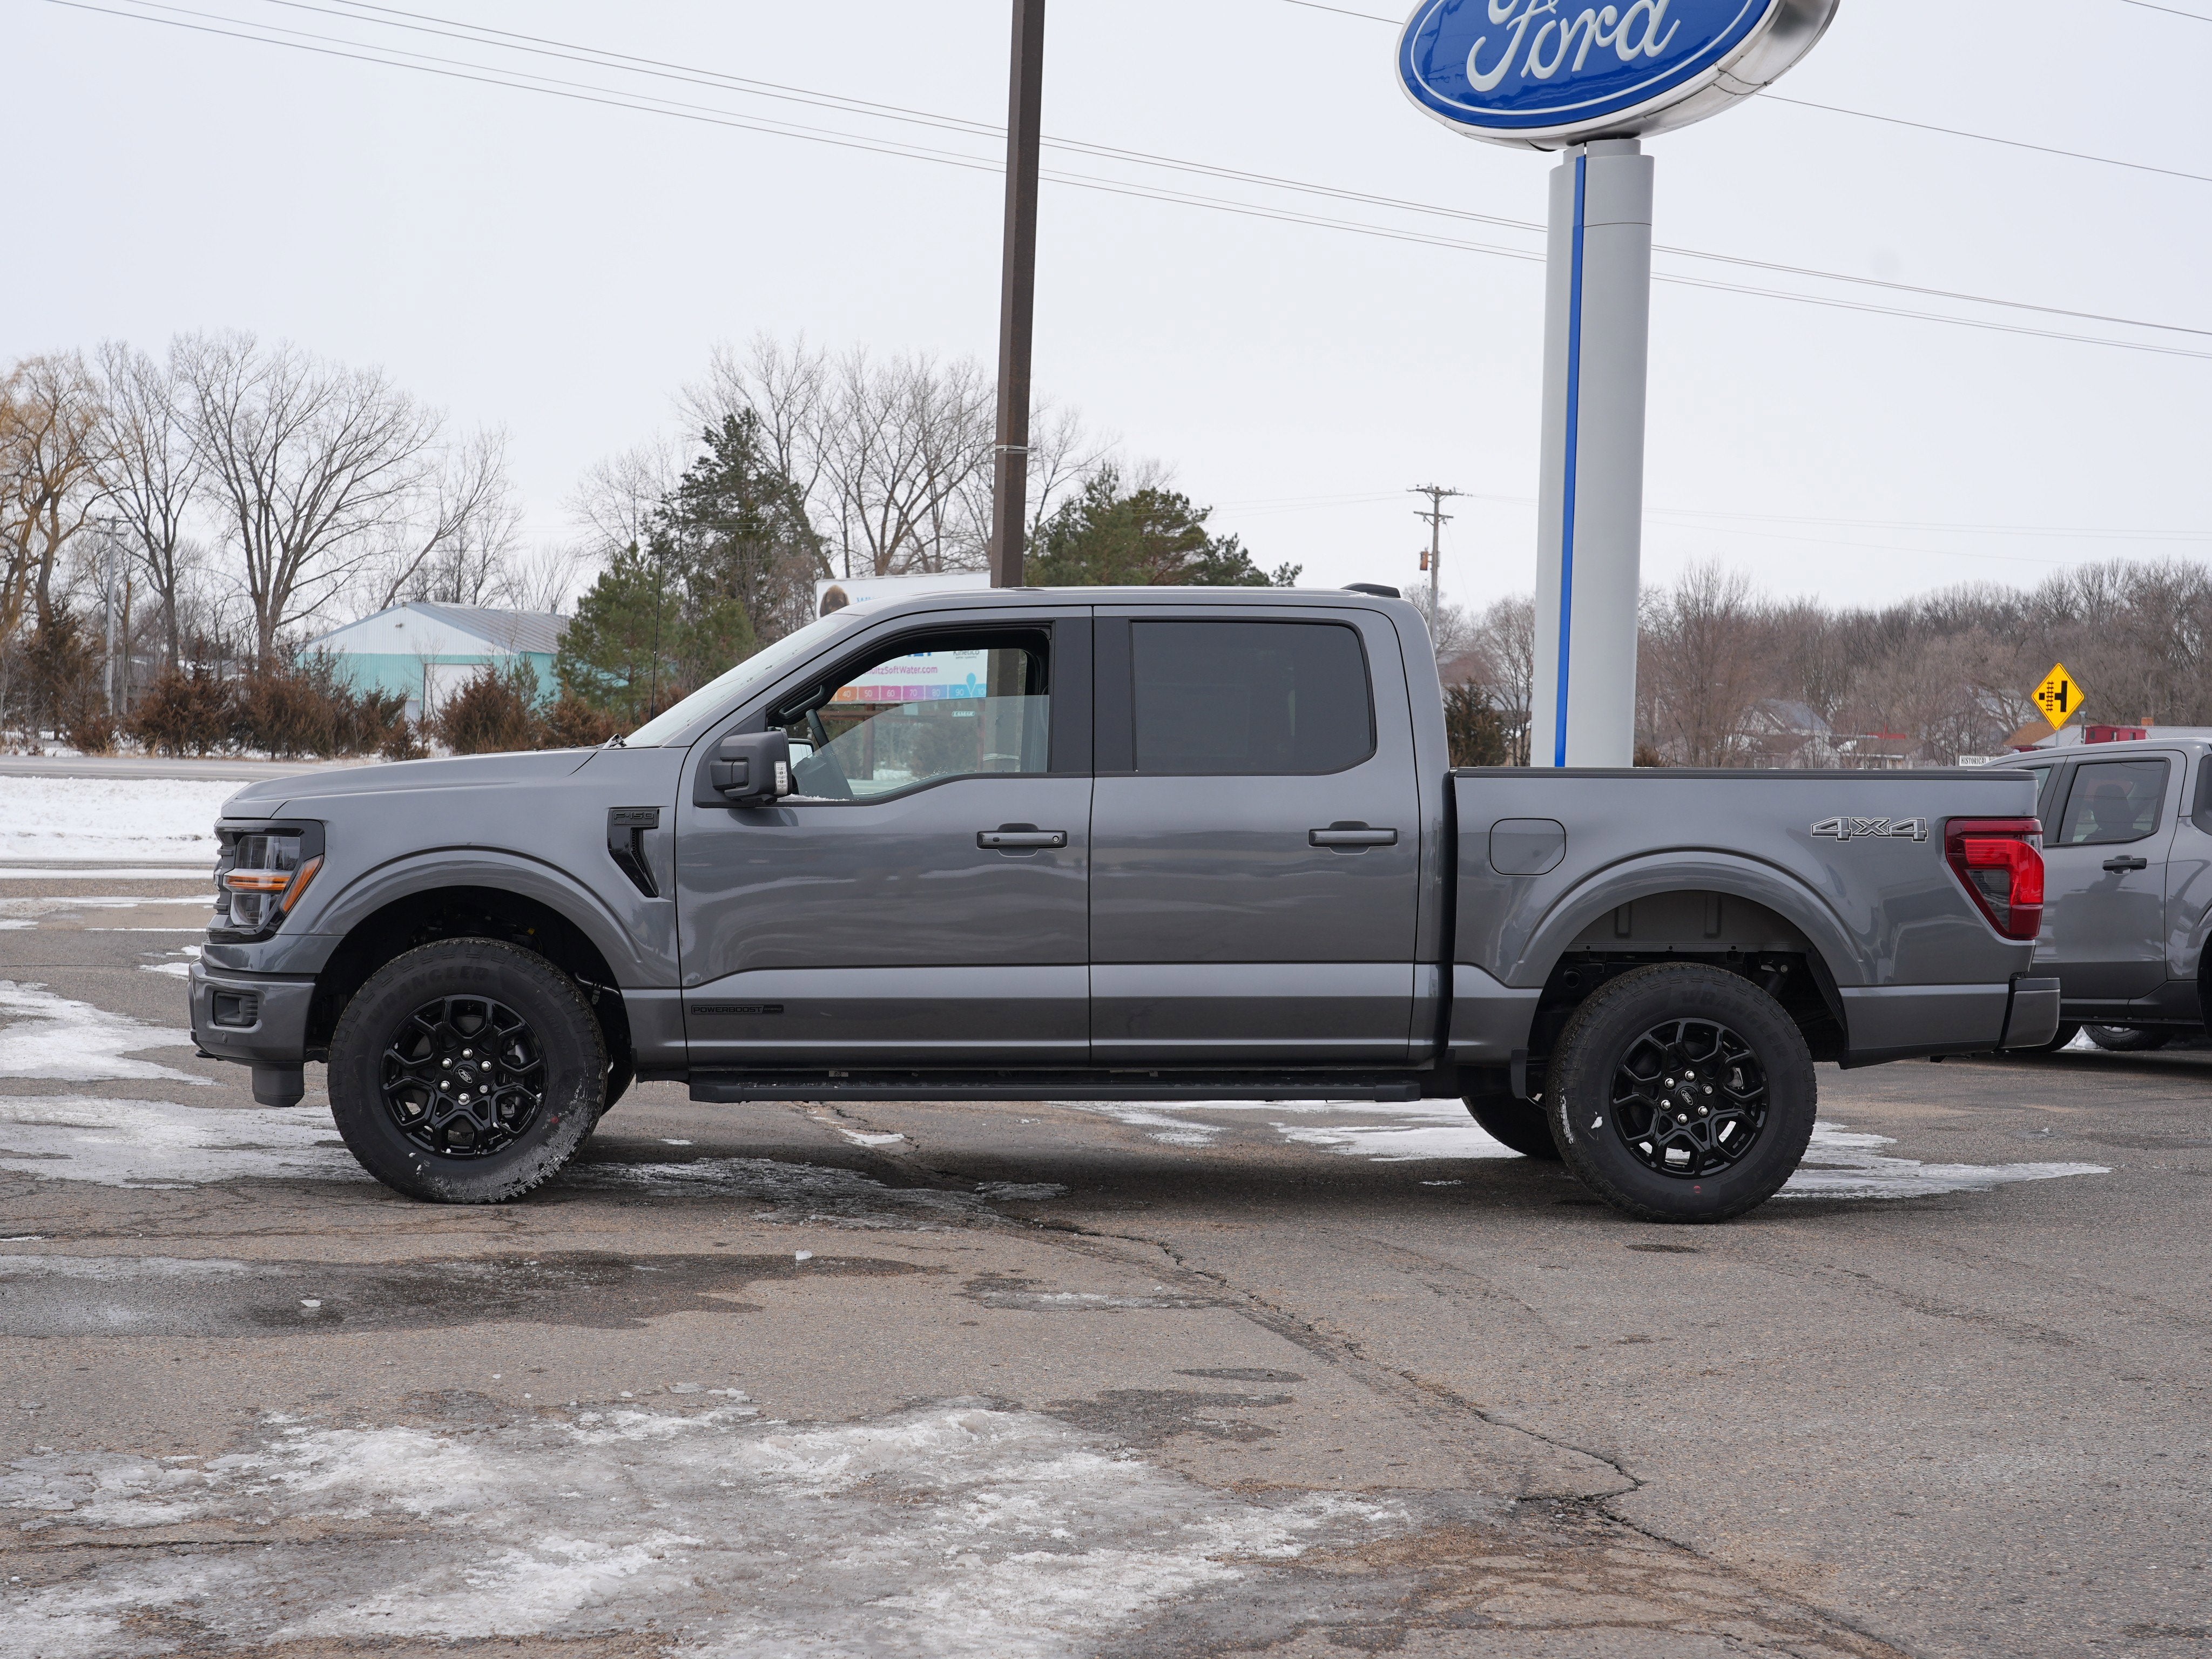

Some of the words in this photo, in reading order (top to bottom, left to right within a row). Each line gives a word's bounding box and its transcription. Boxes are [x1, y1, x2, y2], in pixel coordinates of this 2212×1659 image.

[1466, 0, 1681, 92] Ford
[865, 690, 873, 698] 50
[887, 689, 895, 697] 60
[955, 688, 964, 696] 90
